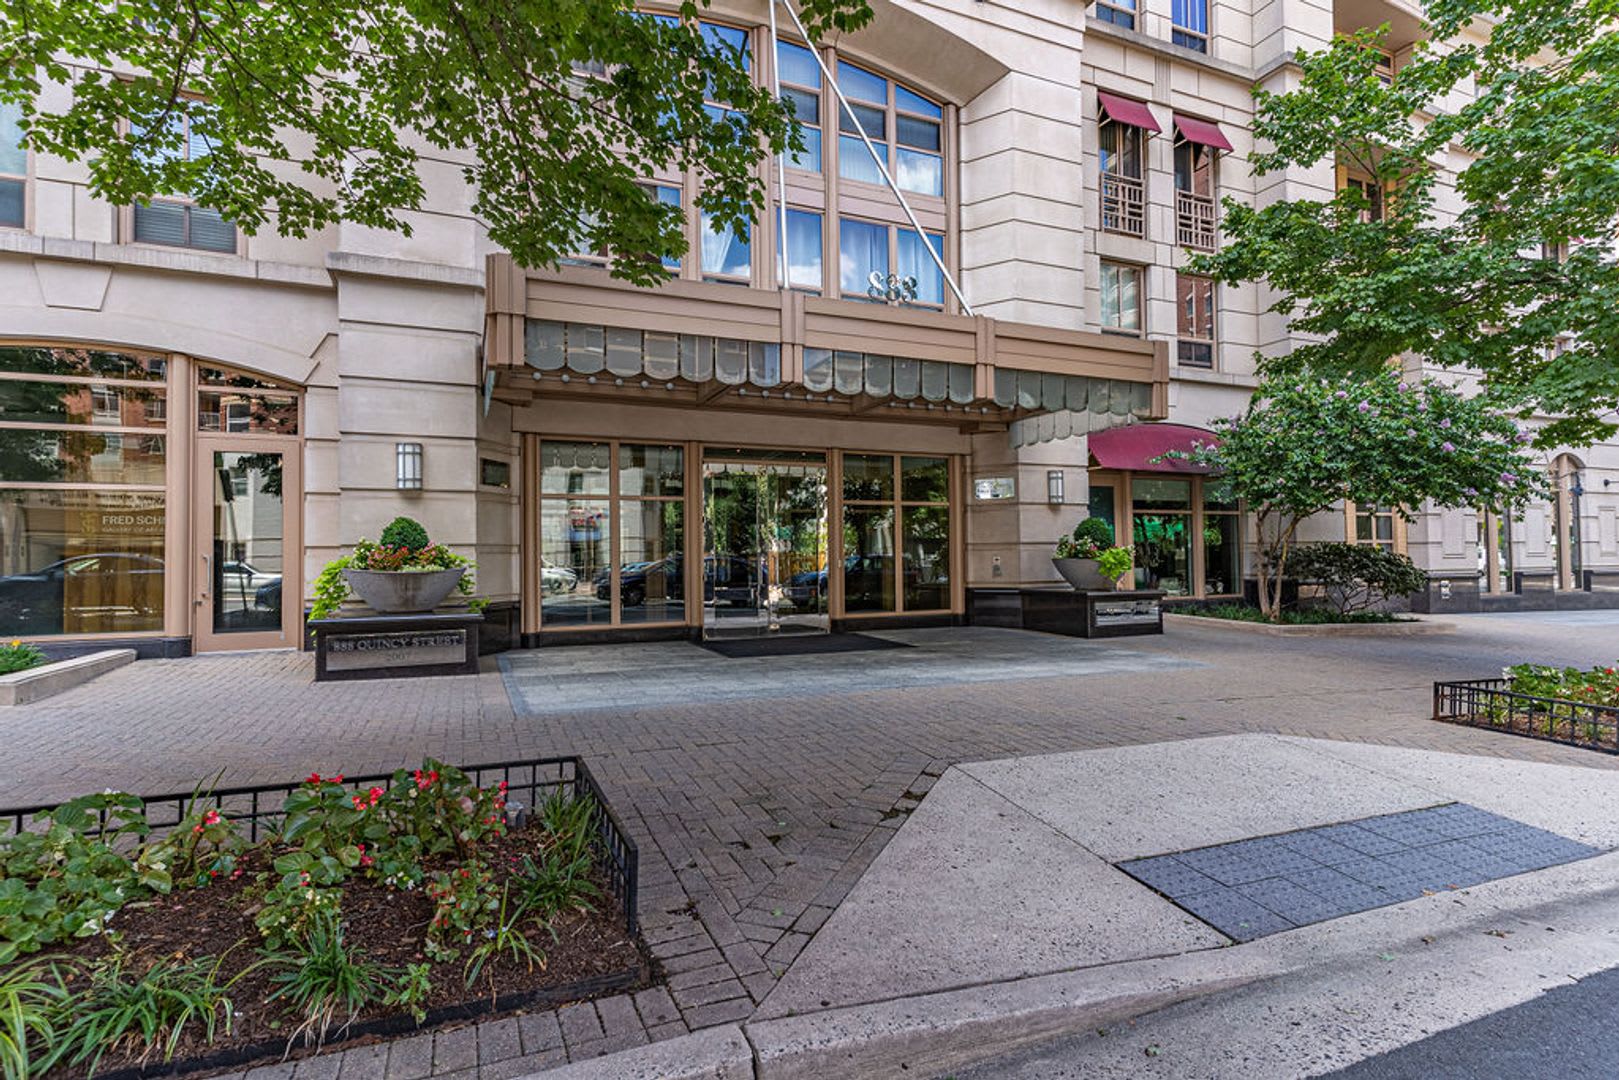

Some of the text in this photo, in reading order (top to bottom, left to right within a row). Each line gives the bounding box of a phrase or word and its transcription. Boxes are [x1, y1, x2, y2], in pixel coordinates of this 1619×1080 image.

[867, 270, 918, 304] 888
[102, 515, 134, 525] FRED
[357, 638, 409, 650] QUINCY
[412, 635, 460, 648] STREET
